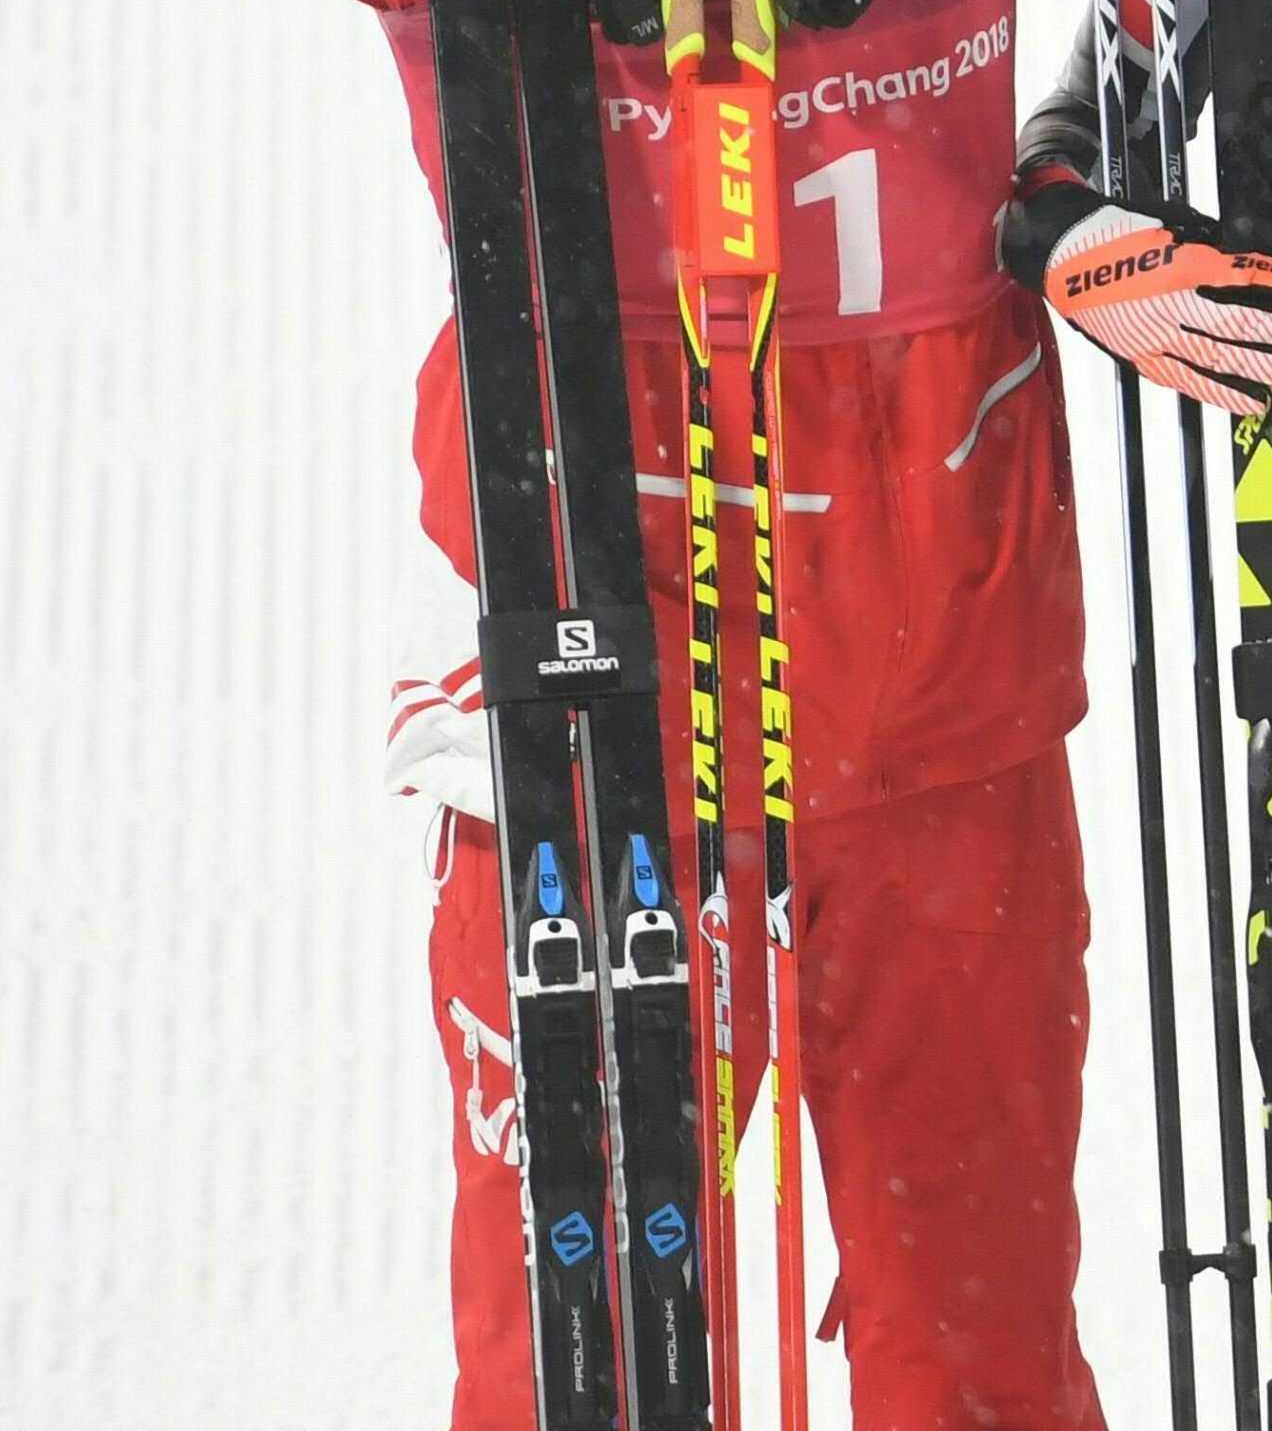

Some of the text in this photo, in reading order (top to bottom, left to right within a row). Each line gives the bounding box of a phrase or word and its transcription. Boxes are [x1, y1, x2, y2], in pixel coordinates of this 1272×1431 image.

[608, 16, 1010, 141] PygChang 2018
[718, 101, 756, 260] LEKI
[793, 148, 883, 316] 1
[1065, 242, 1180, 298] ziener
[537, 656, 619, 675] salomon
[760, 636, 794, 824] LEKI
